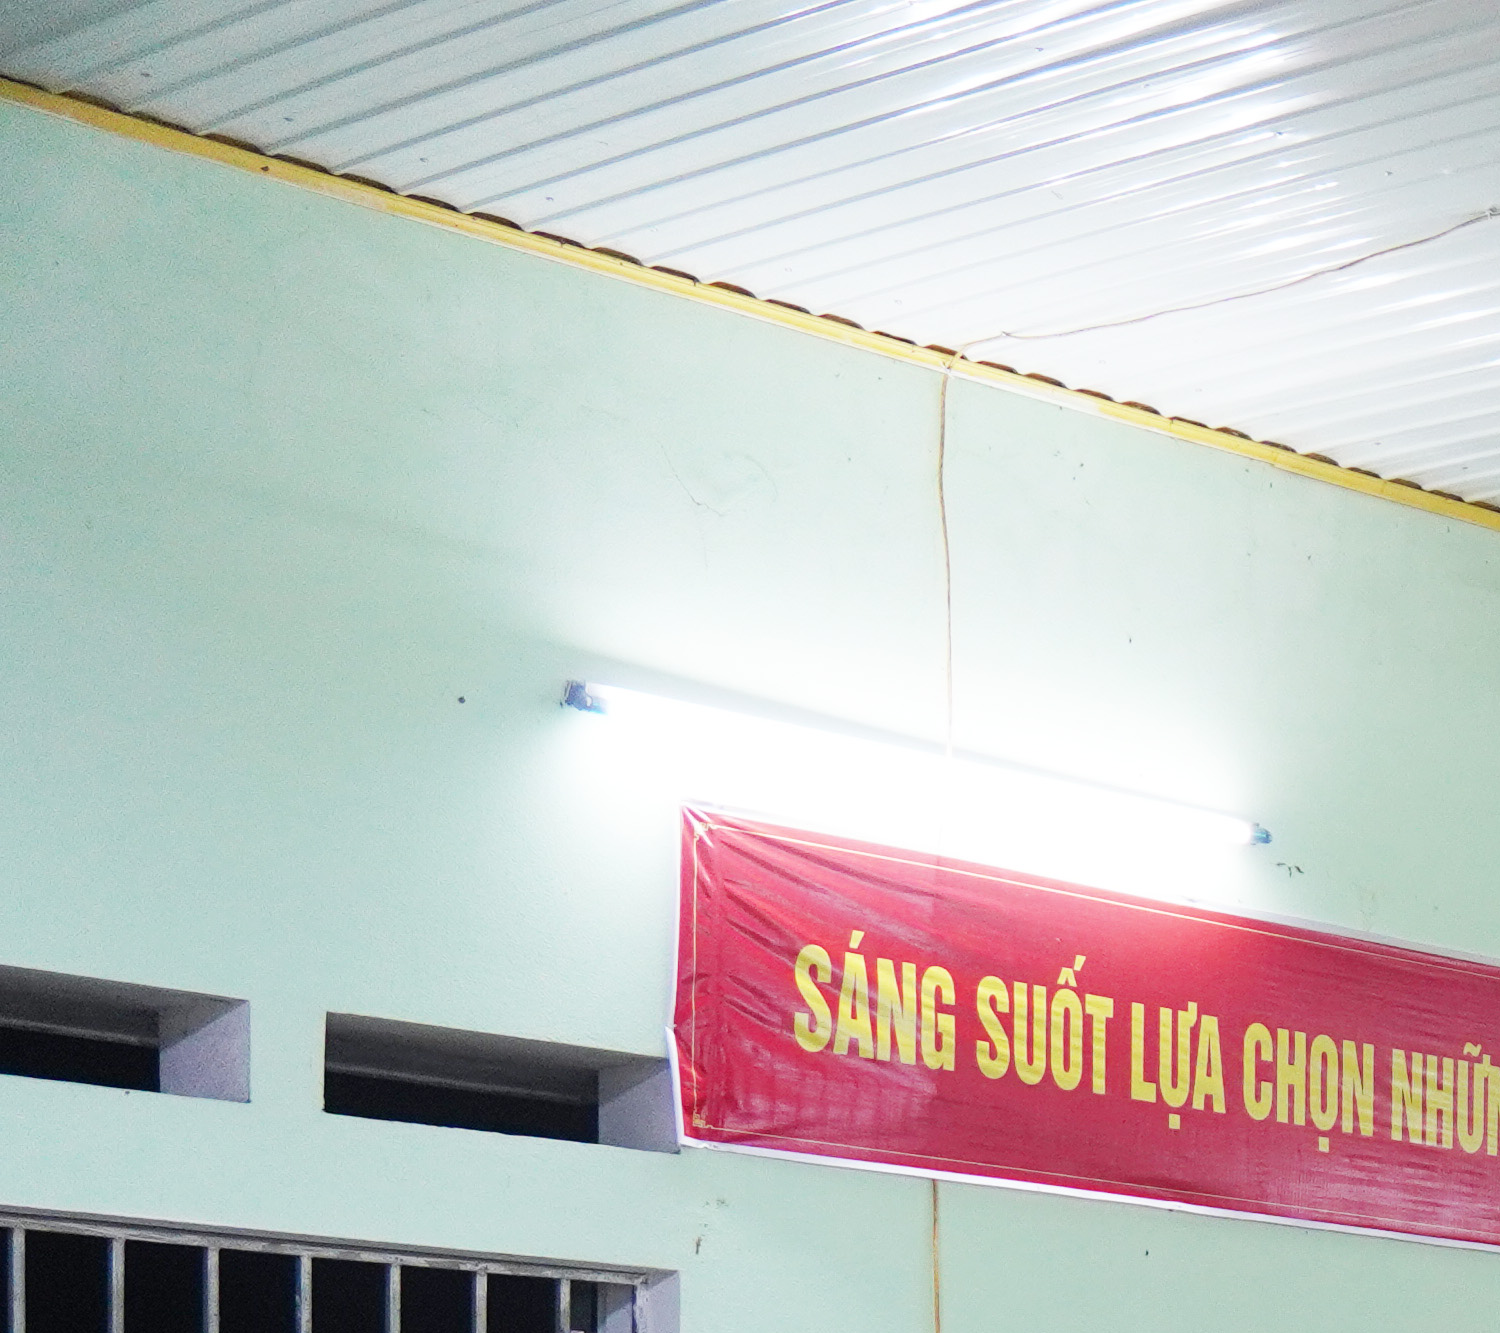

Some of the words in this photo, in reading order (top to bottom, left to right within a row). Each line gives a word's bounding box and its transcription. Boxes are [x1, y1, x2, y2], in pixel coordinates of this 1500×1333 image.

[794, 930, 956, 1071] SÁNG
[976, 955, 1114, 1095] SUỐT
[1130, 1001, 1226, 1129] LỰA
[1243, 1022, 1374, 1153] CHỌN
